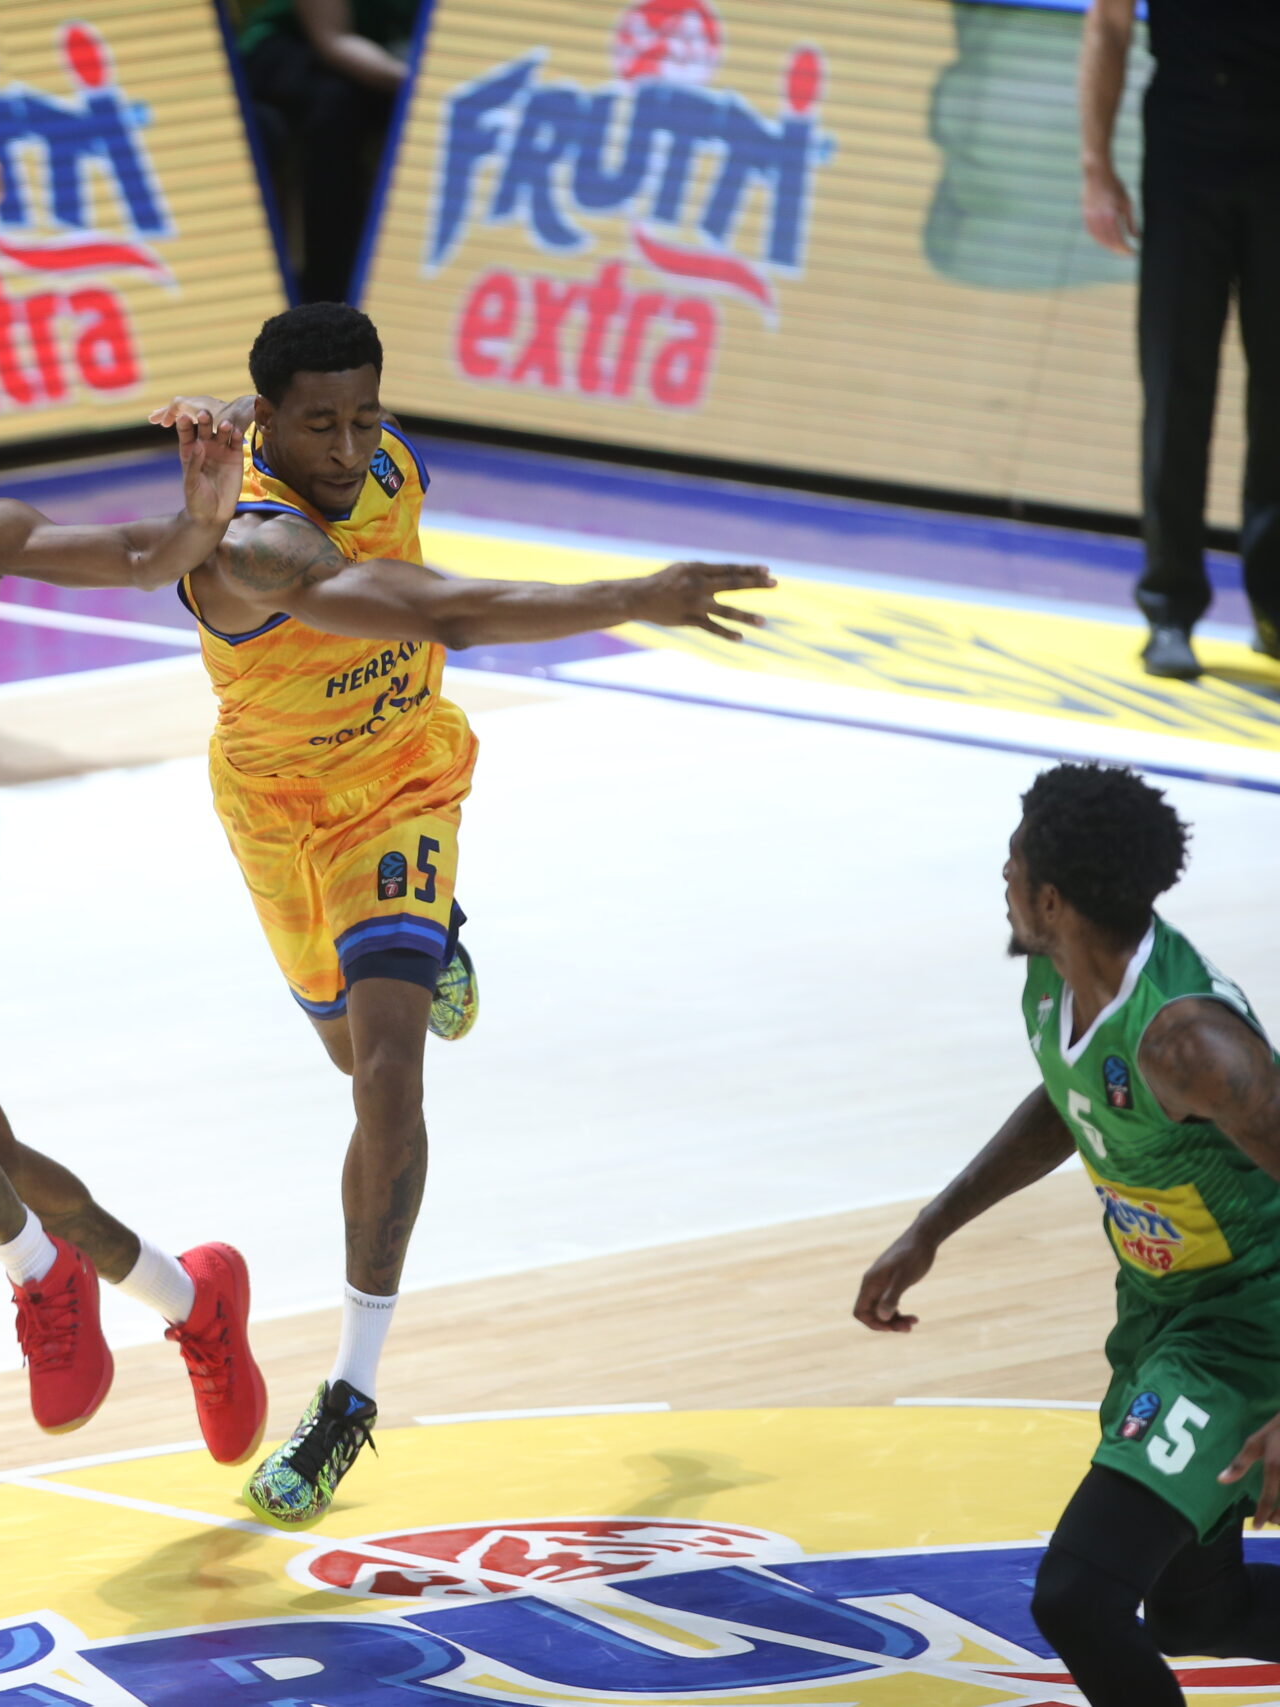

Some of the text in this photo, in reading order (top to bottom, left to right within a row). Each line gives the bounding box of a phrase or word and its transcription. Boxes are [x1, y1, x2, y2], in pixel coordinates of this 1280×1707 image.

[425, 46, 820, 272] FRUTTI
[455, 260, 714, 408] extra
[414, 834, 440, 904] 5
[1146, 1394, 1211, 1476] 5
